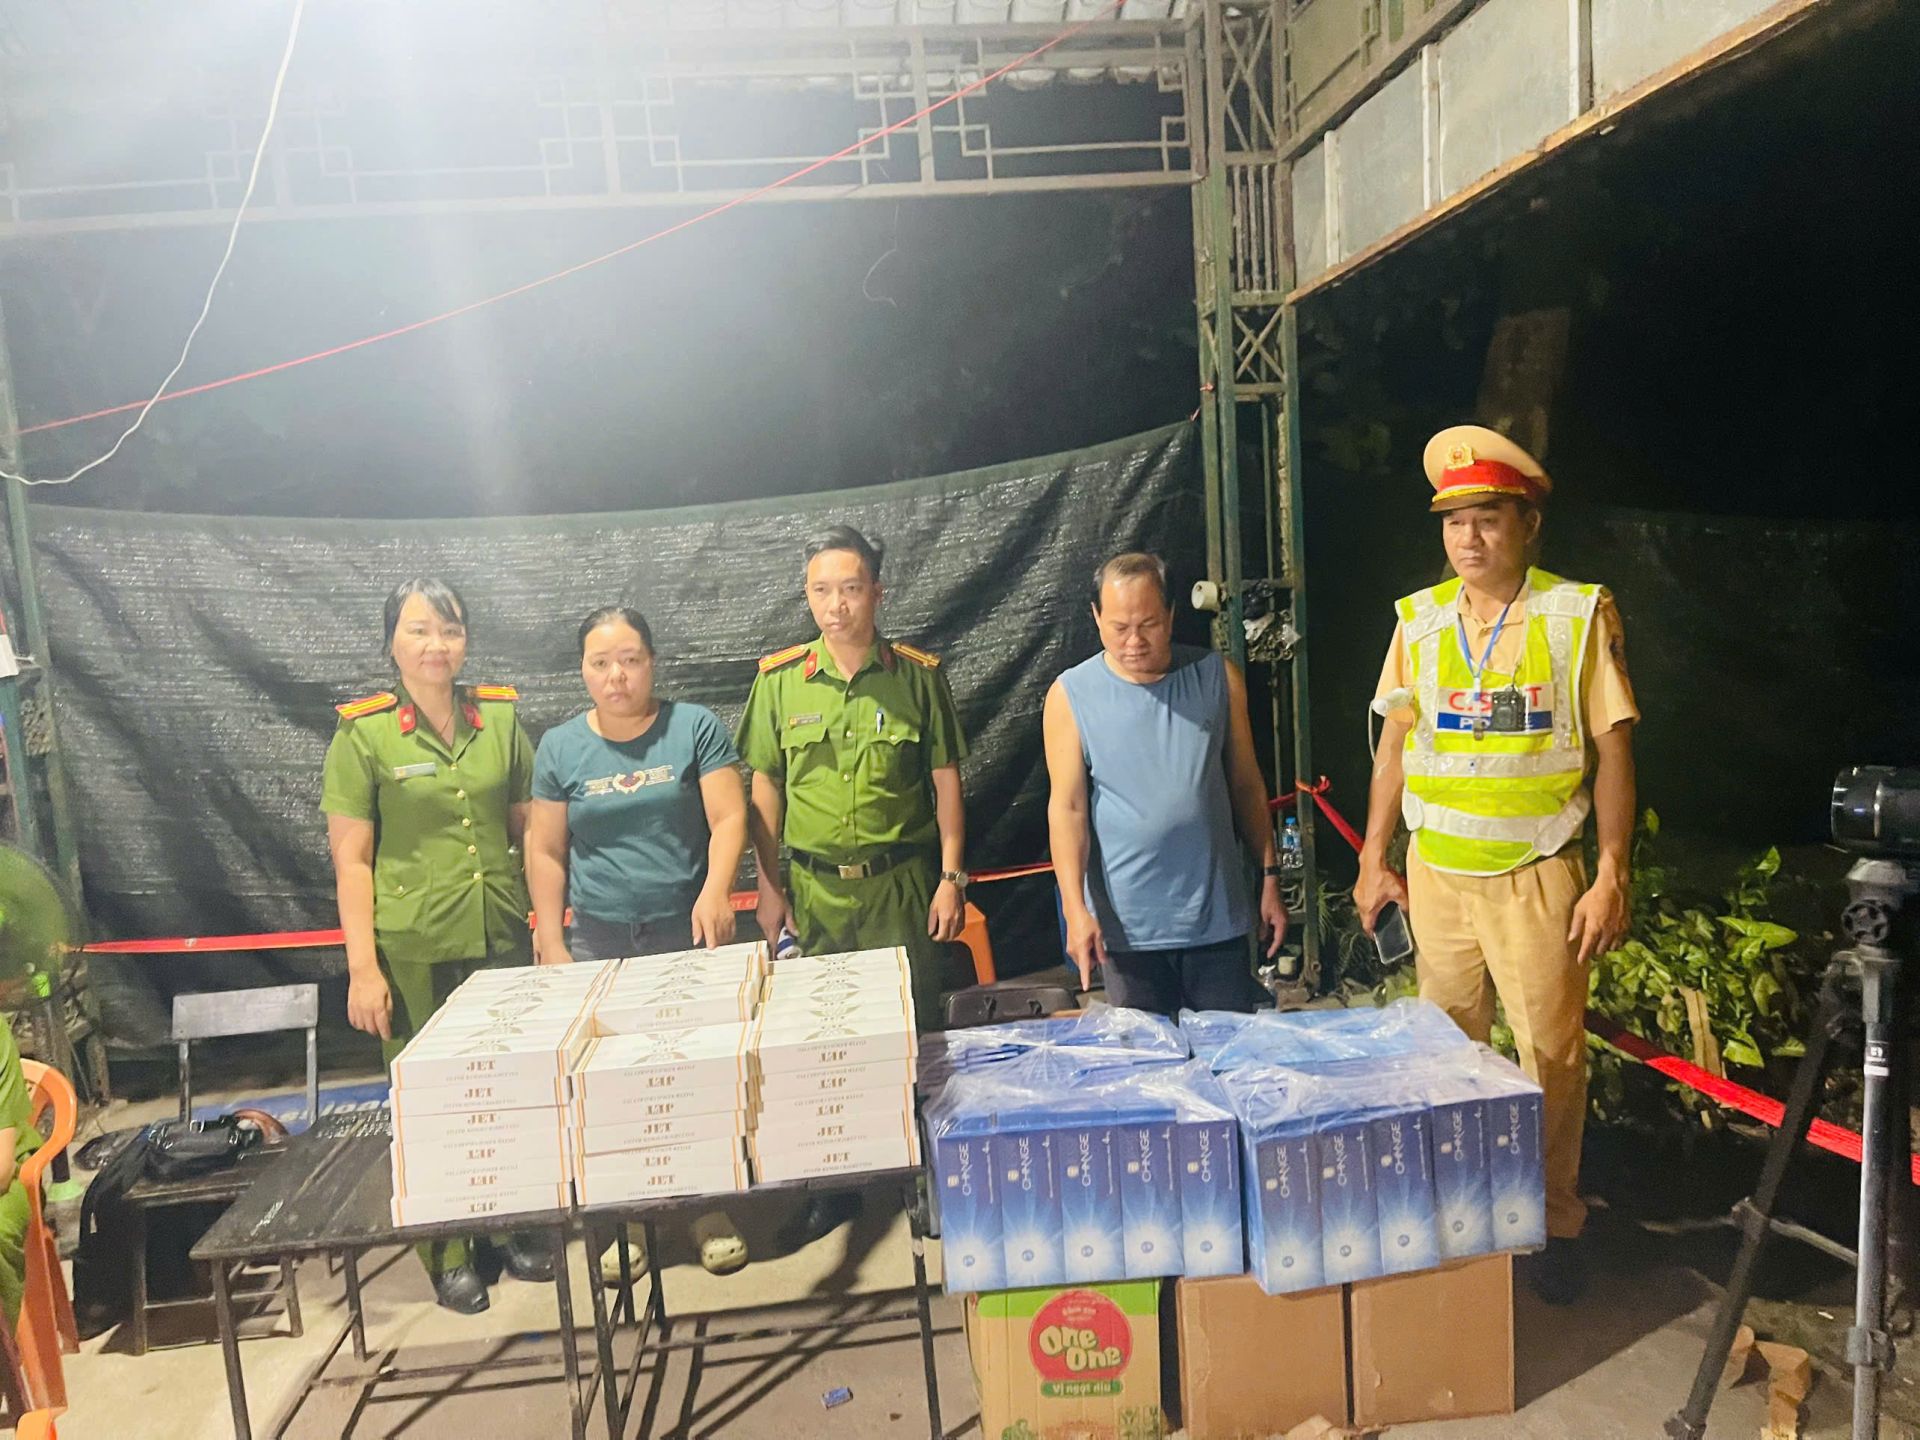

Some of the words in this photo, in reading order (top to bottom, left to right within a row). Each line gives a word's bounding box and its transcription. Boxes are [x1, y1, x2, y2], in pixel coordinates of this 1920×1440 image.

[1448, 687, 1542, 711] C.ST
[466, 1060, 496, 1072] JET
[464, 1087, 494, 1099] JET
[467, 1113, 497, 1125] JET
[643, 1121, 673, 1134] JET
[817, 1125, 845, 1137] JET
[822, 1151, 851, 1164] JET
[1079, 1132, 1093, 1187] CHANGE
[1139, 1128, 1153, 1183] CHANGE
[1199, 1128, 1213, 1183] CHANGE
[1333, 1132, 1348, 1187] CHANGE
[1390, 1120, 1405, 1175] CHANGE
[958, 1142, 973, 1196] CHANGE
[1018, 1136, 1032, 1191] CHANGE
[1276, 1144, 1290, 1199] CHANGE
[647, 1174, 676, 1186] JET
[1039, 1325, 1098, 1356] One
[1066, 1346, 1122, 1372] One
